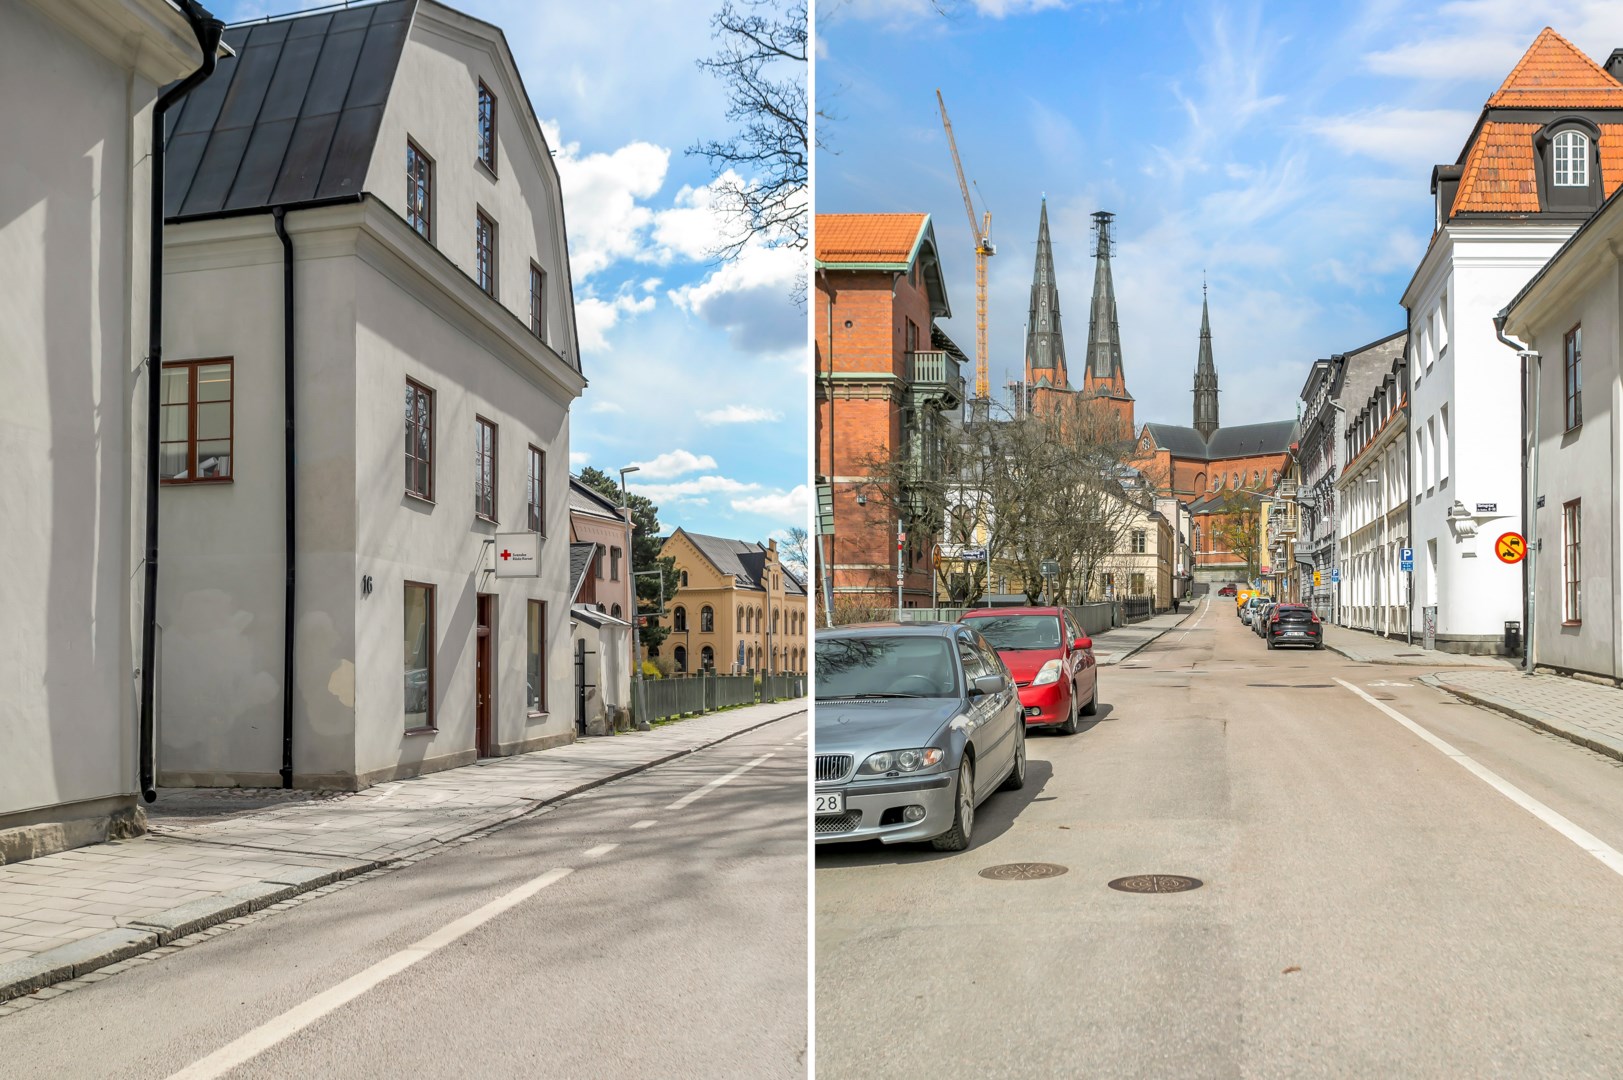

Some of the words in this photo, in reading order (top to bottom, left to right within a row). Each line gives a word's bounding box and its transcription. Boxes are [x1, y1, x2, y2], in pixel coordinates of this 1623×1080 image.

[1404, 550, 1411, 560] P
[363, 575, 373, 594] 16
[816, 796, 837, 811] 28
